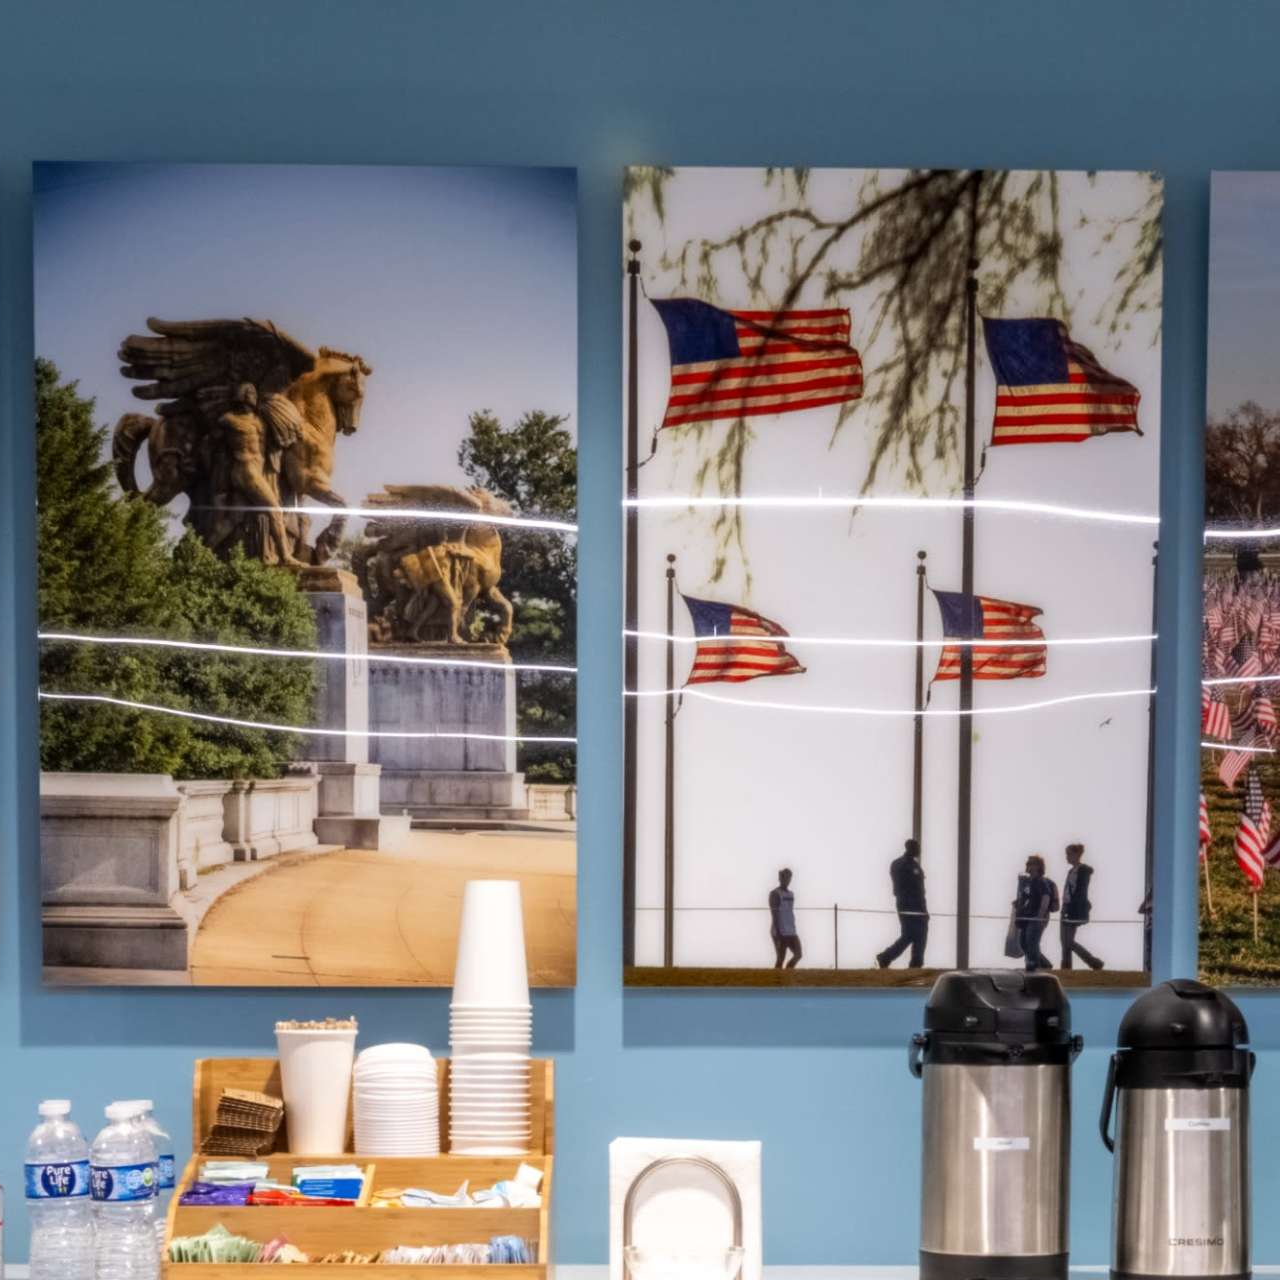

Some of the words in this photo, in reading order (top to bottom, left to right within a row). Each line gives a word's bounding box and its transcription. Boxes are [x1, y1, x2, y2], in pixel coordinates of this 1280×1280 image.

[46, 1166, 71, 1176] Pure
[49, 1175, 70, 1187] Life
[1167, 1238, 1224, 1247] CRESIMO
